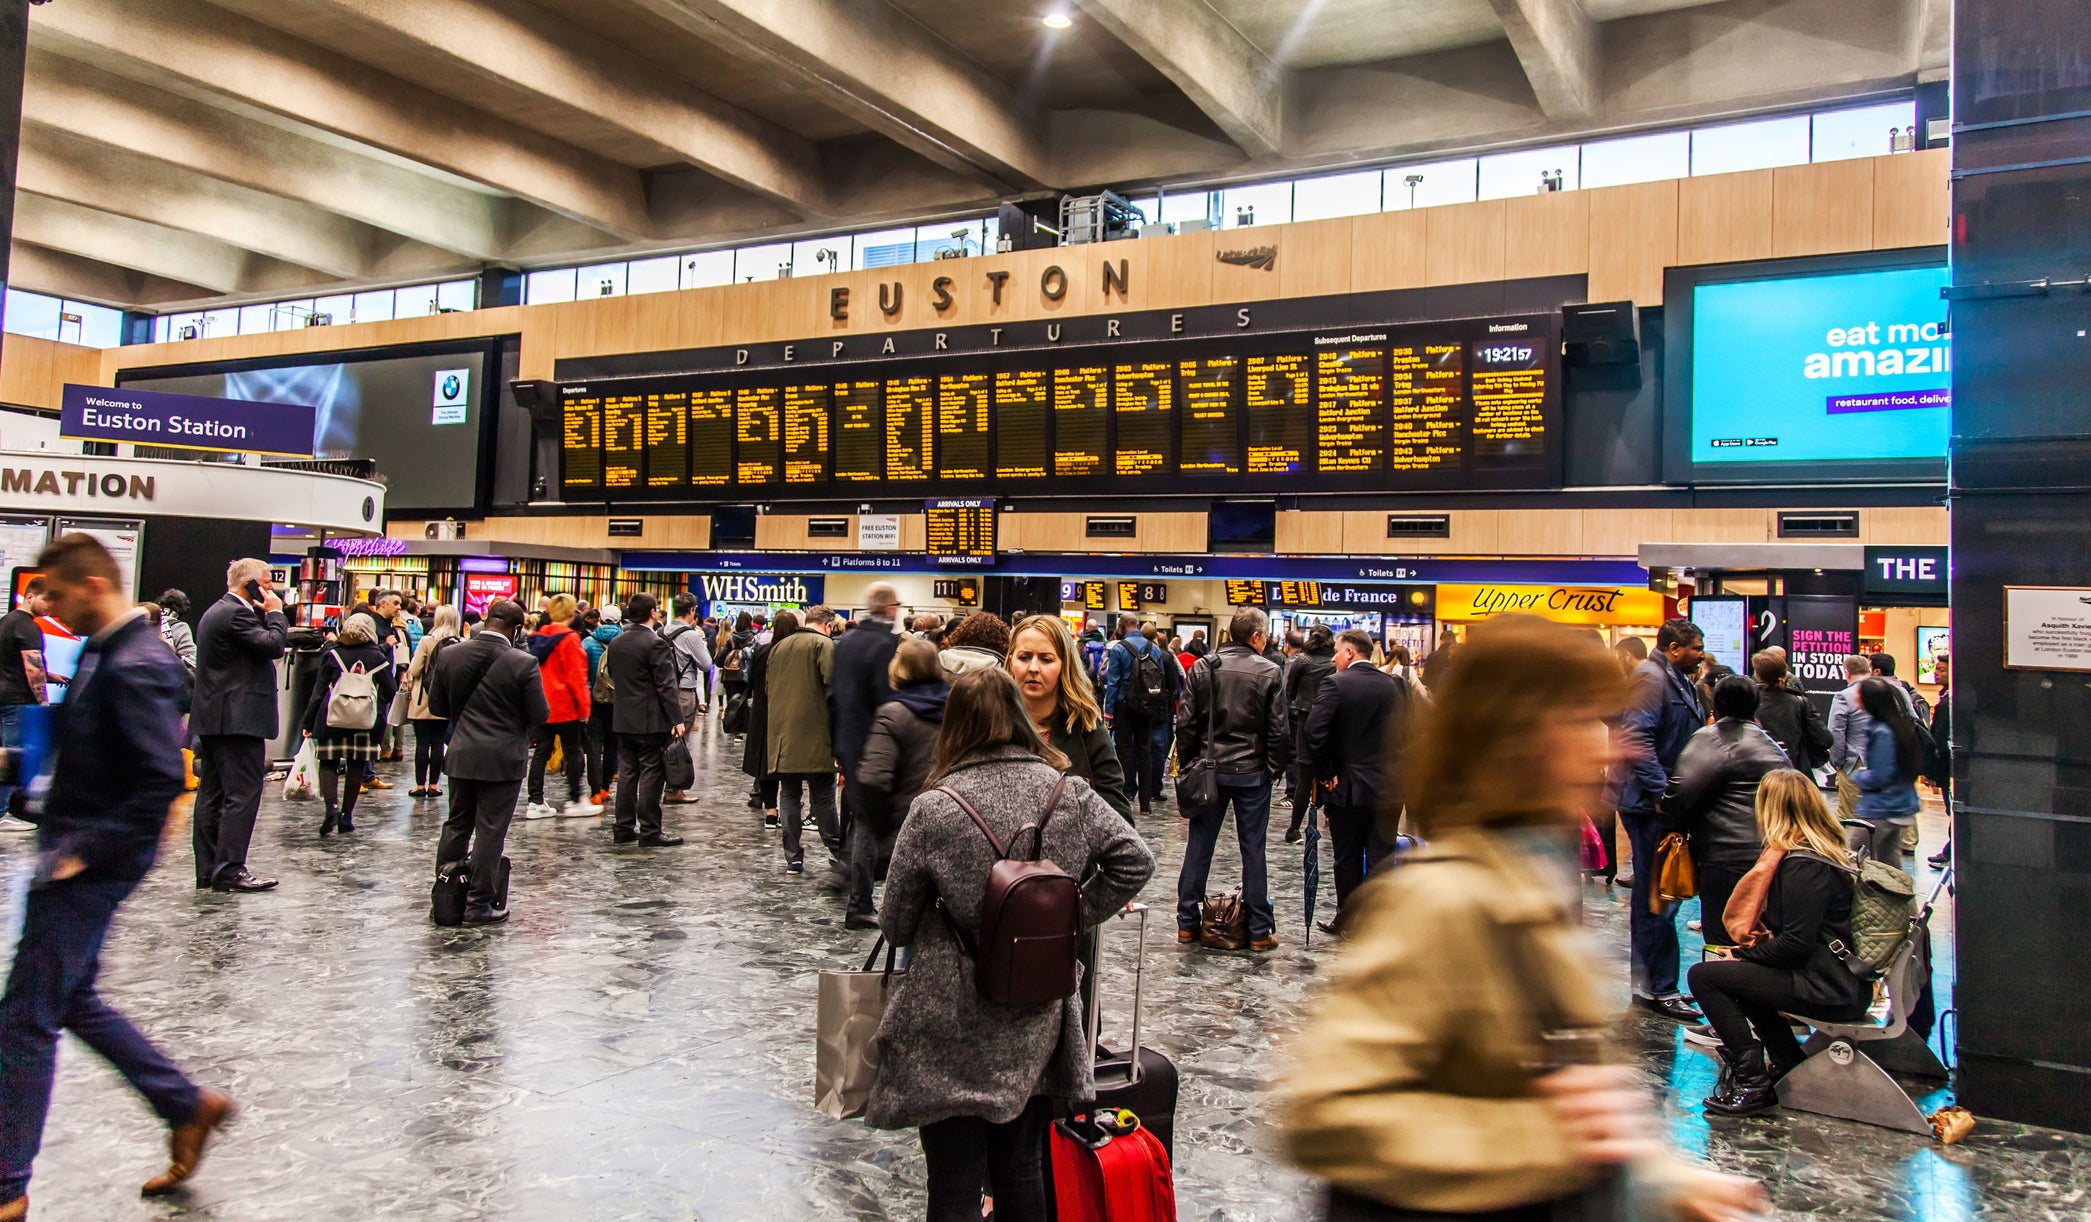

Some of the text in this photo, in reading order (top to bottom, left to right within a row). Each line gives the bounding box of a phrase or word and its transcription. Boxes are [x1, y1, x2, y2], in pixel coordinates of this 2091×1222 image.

[830, 259, 1128, 318] EUSTON
[1489, 324, 1528, 333] Information
[1826, 321, 1951, 347] eat mo
[736, 308, 1250, 365] DEPARTURES
[1314, 333, 1387, 345] Subsequent Departures
[86, 397, 142, 410] Welcome to
[1835, 397, 1889, 408] restaurant
[1891, 395, 1918, 406] food,
[82, 408, 246, 438] Euston Station
[1, 468, 155, 501] MATION
[842, 557, 901, 567] Platforms 8 to 11
[1877, 557, 1936, 580] THE
[1161, 565, 1183, 573] Toilets
[1368, 569, 1394, 577] Toilets
[274, 571, 285, 582] 12
[701, 575, 808, 603] WHSmith
[936, 582, 947, 595] 11
[1062, 584, 1072, 598] 9
[1077, 585, 1082, 598] 9
[1144, 586, 1154, 600] 8
[1159, 587, 1165, 600] 8
[1323, 587, 1340, 602] de
[1344, 588, 1397, 603] France
[1470, 588, 1624, 616] Upper Crust
[1792, 630, 1851, 642] SIGN THE
[1792, 641, 1851, 653] PETITION
[1792, 652, 1806, 663] IN
